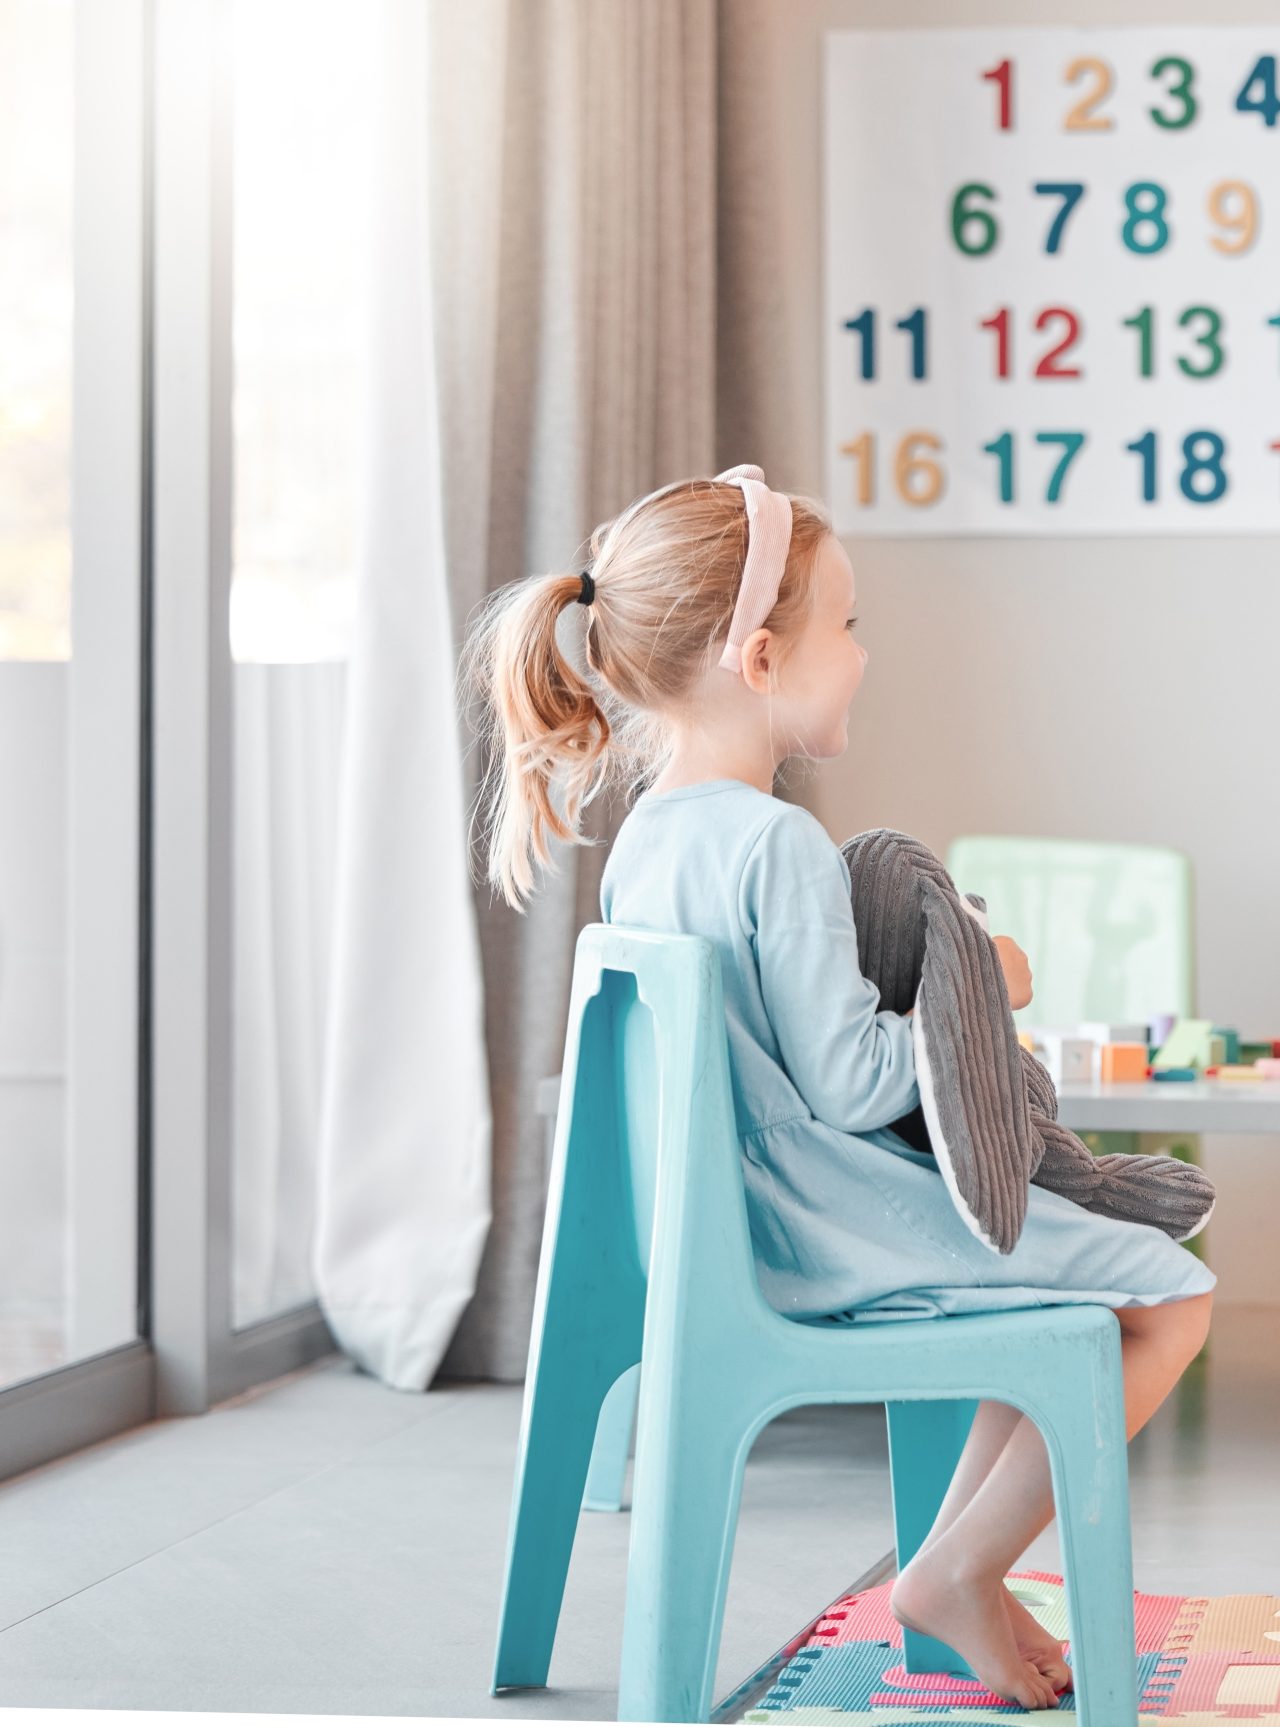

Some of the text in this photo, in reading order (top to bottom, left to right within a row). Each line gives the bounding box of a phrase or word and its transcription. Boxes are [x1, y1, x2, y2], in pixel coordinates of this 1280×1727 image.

[982, 58, 1013, 131] 1
[1064, 57, 1112, 131] 2
[1150, 57, 1197, 130] 3
[950, 183, 997, 257] 6
[1033, 183, 1085, 256] 7
[1120, 181, 1170, 256] 8
[1208, 181, 1257, 255] 9
[845, 308, 926, 381] 11
[980, 307, 1081, 380] 12
[1123, 306, 1225, 379] 13
[841, 431, 944, 507] 16
[983, 430, 1086, 504] 17
[1126, 429, 1229, 505] 18
